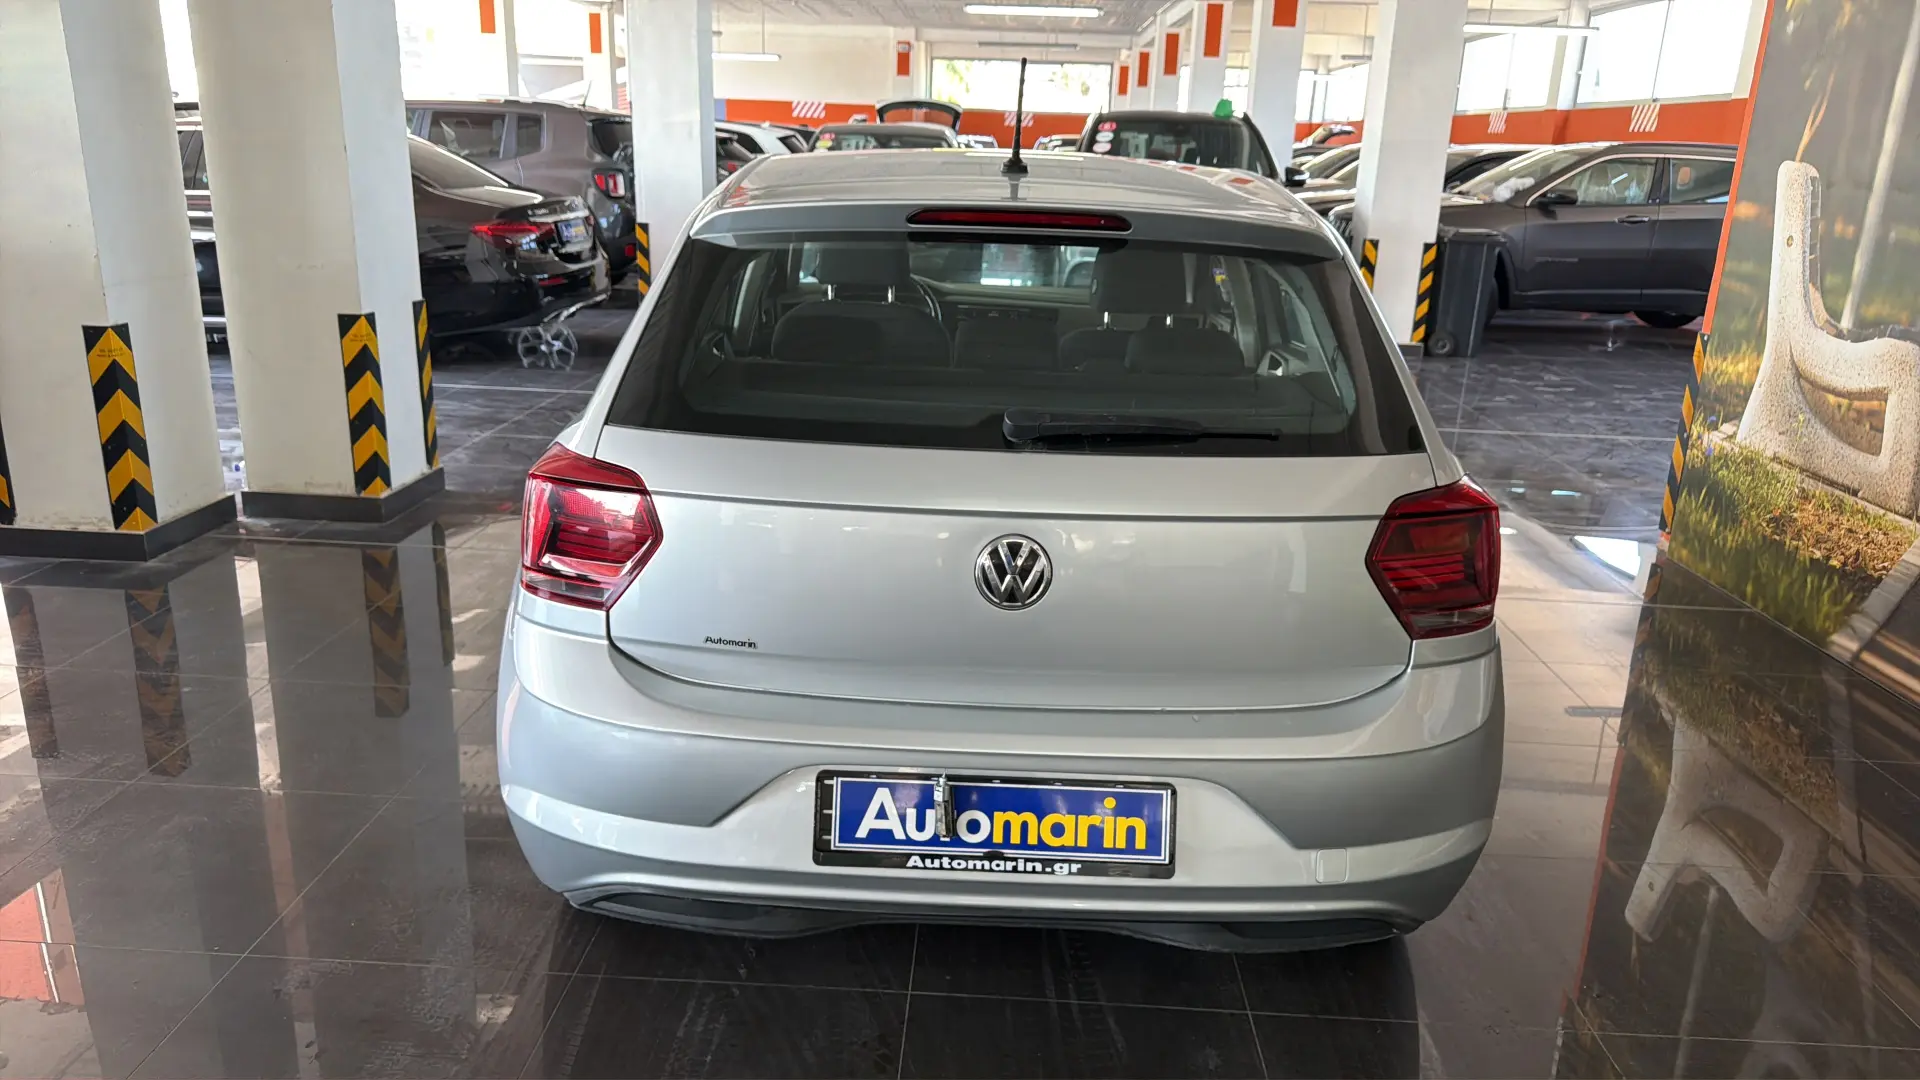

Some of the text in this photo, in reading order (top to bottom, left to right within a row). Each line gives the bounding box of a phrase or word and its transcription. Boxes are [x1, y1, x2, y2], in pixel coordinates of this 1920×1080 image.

[979, 537, 1047, 606] VW
[704, 635, 757, 649] Automarin
[855, 786, 1147, 850] Auomarin
[906, 855, 1082, 875] Automarin.gr
